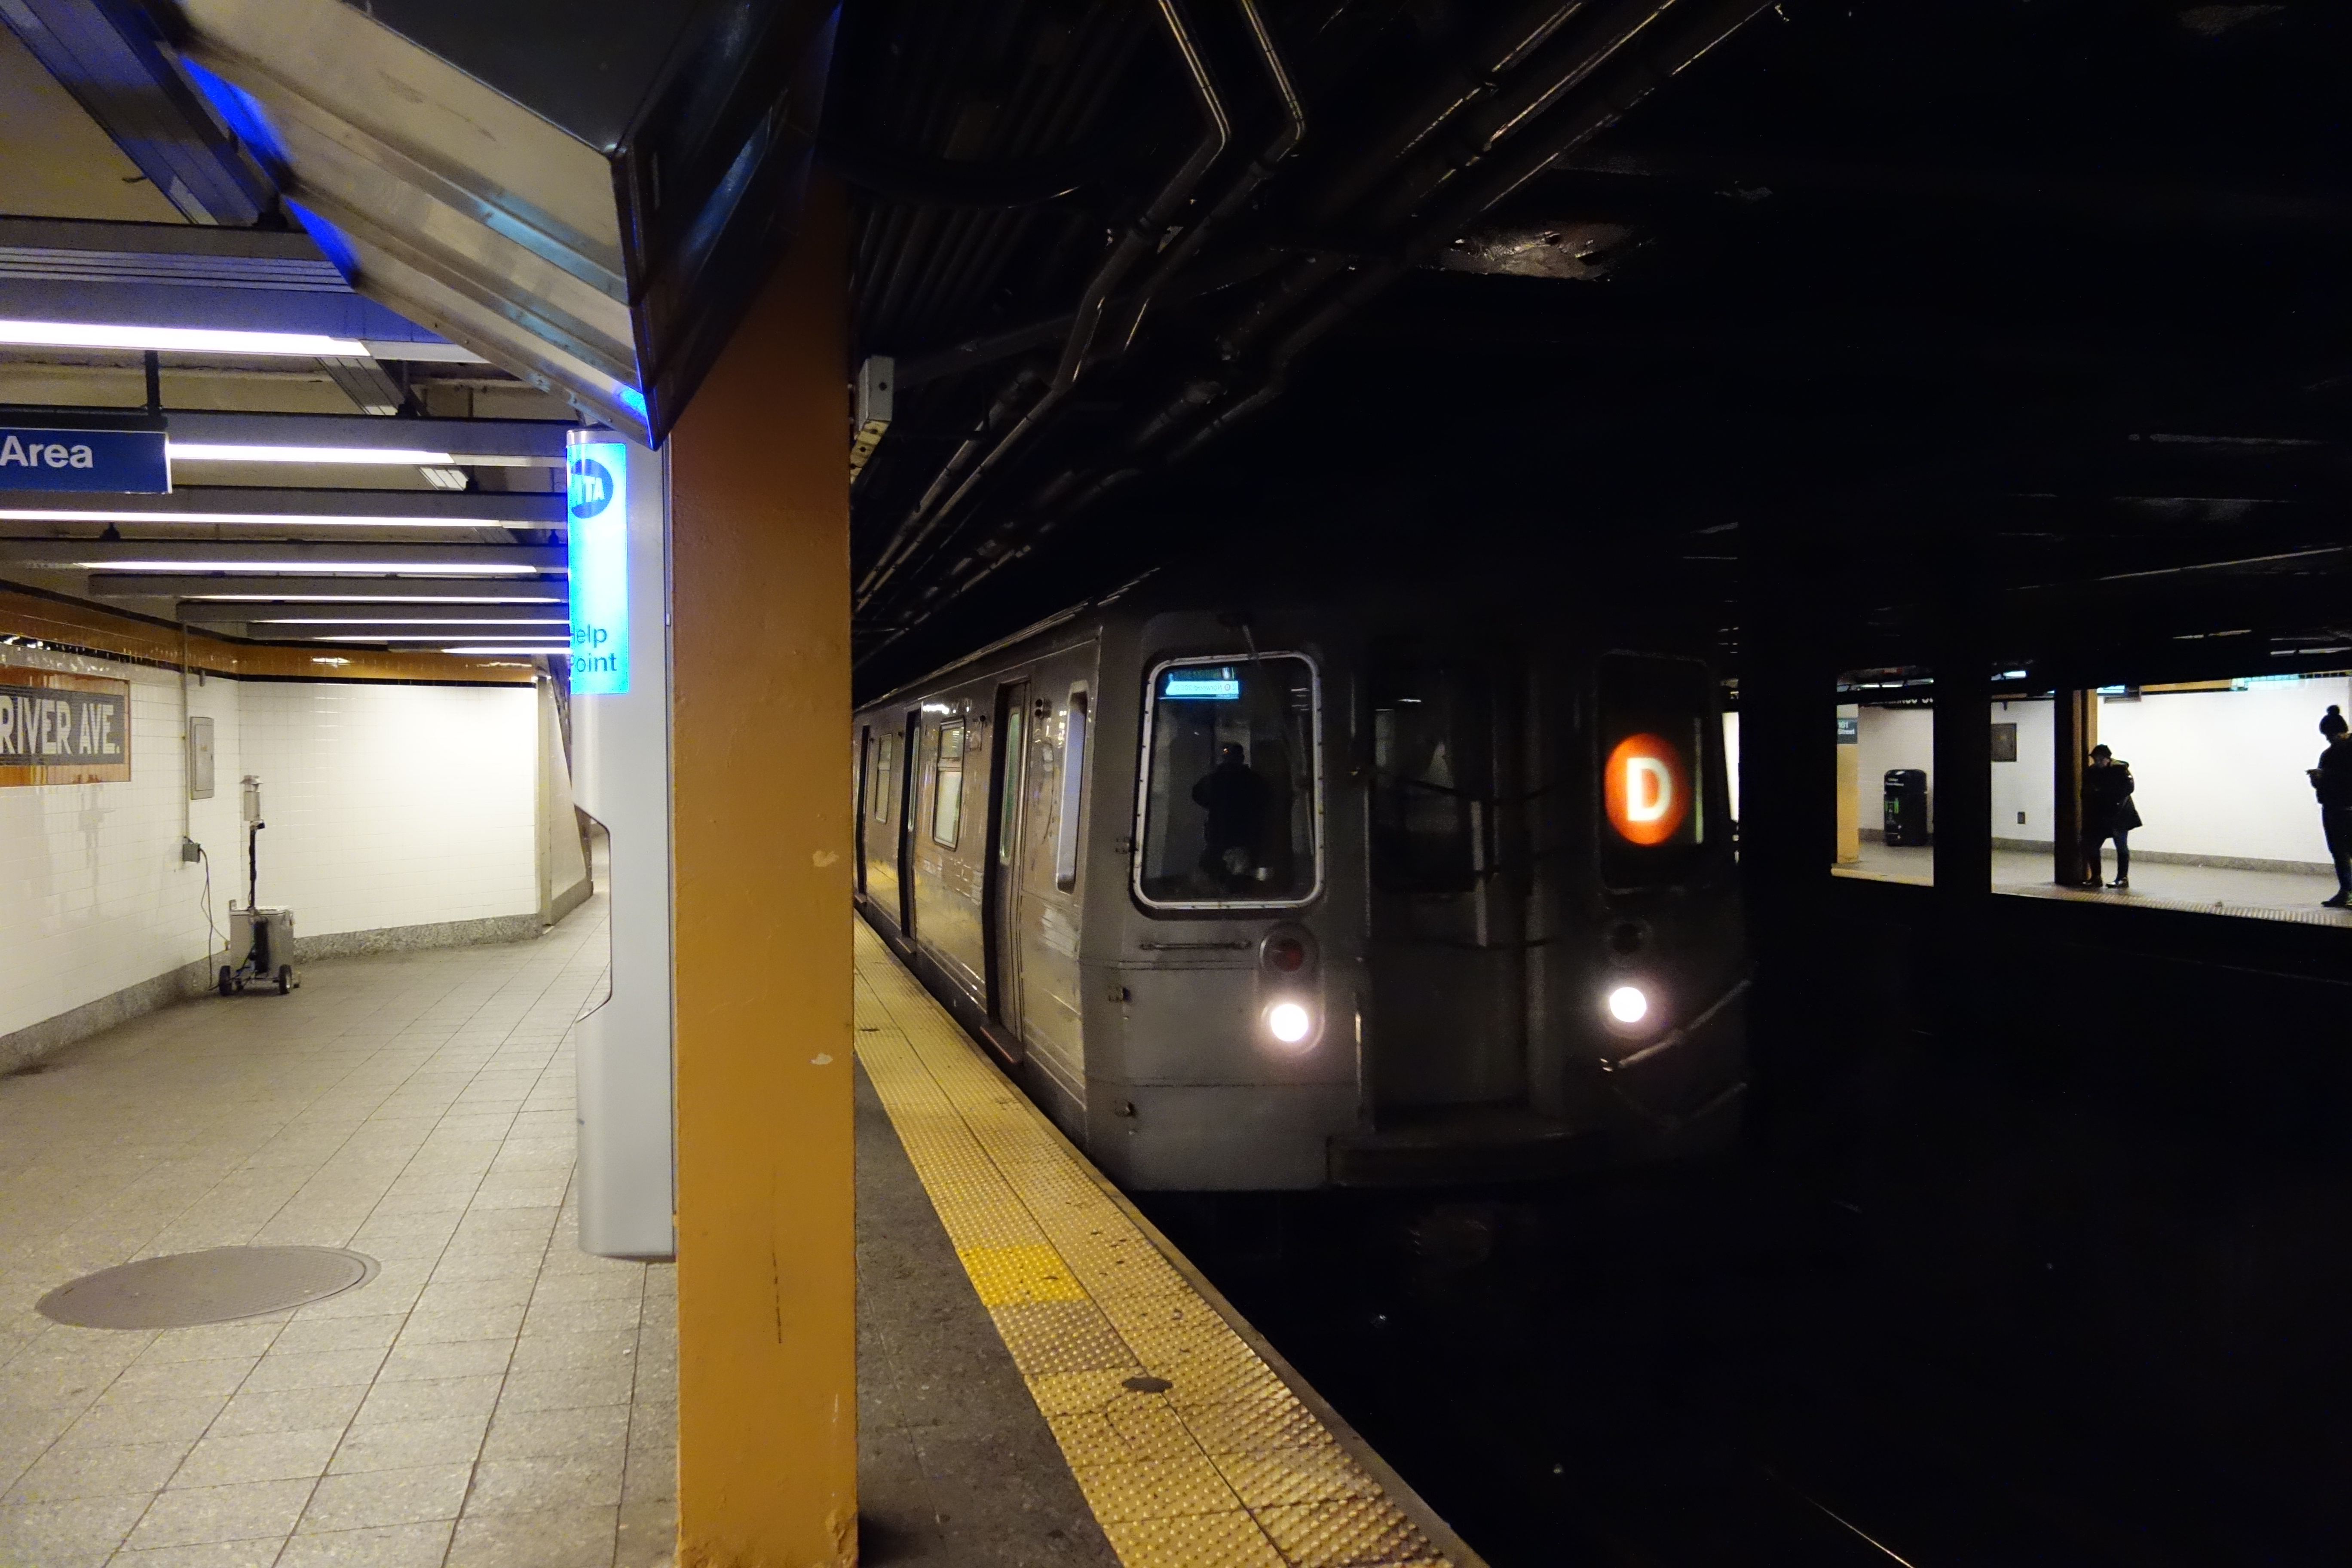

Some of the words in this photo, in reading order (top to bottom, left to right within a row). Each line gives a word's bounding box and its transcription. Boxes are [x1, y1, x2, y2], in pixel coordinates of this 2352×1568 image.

[0, 435, 93, 468] Area
[0, 695, 72, 754] RIVER
[79, 703, 119, 754] AVE.
[1626, 757, 1671, 821] D
